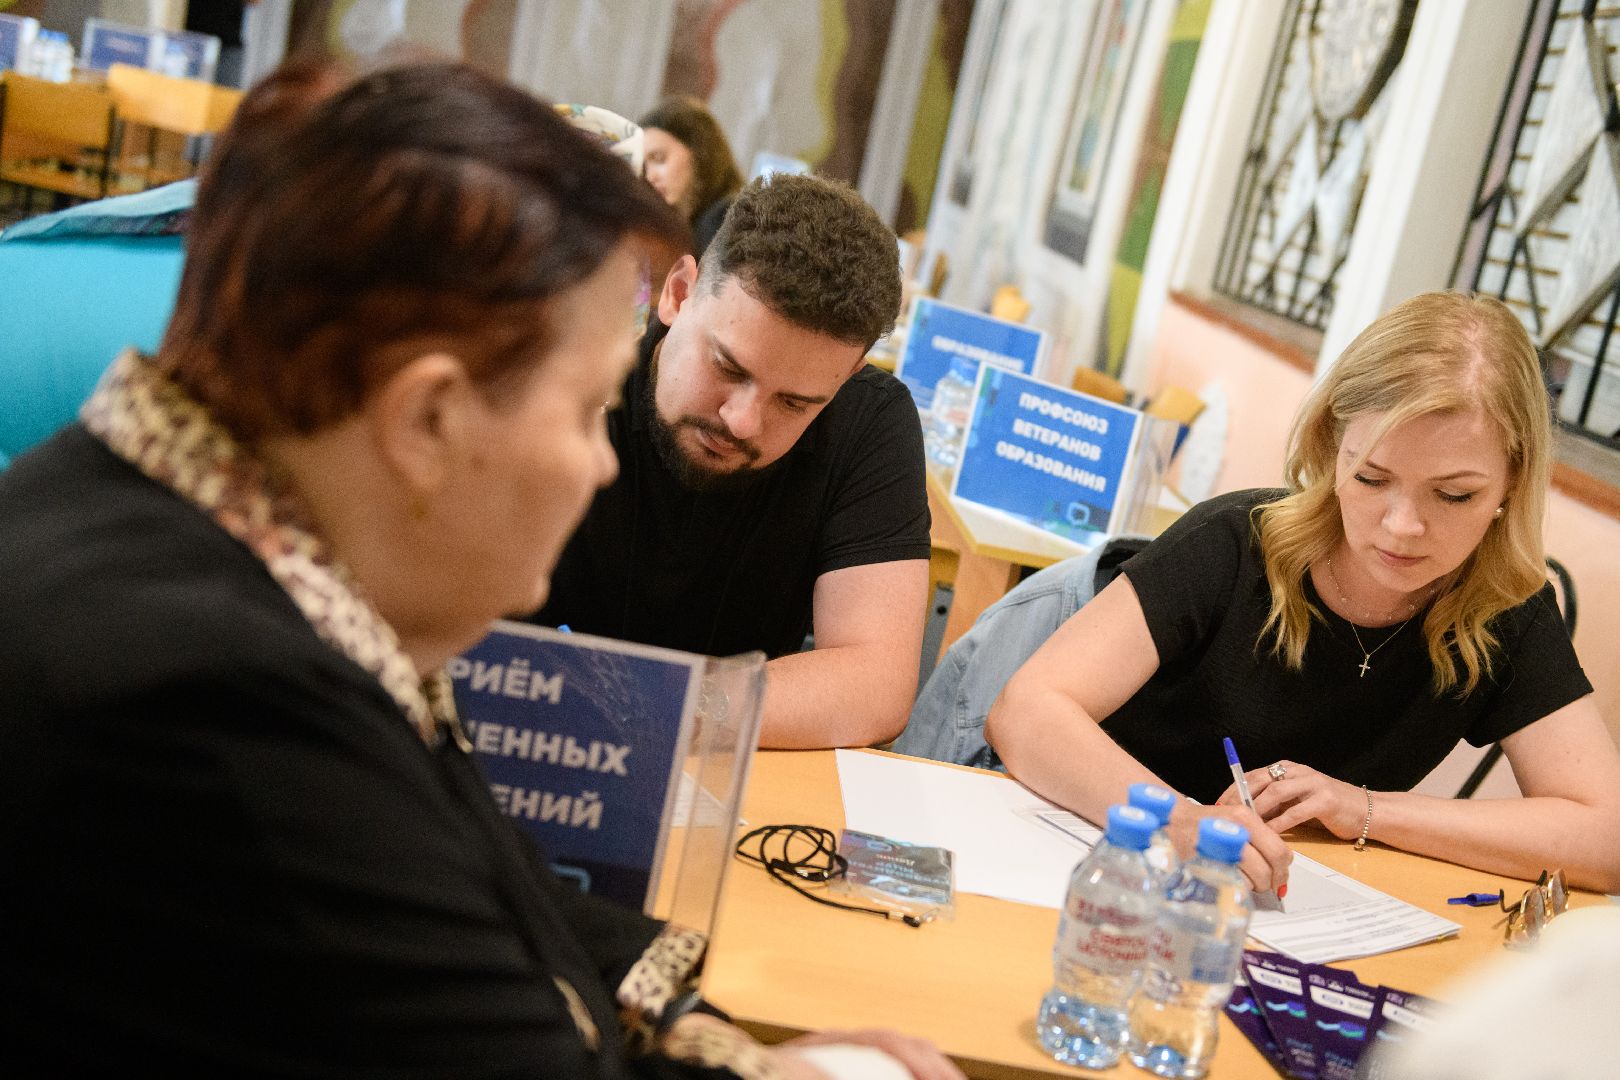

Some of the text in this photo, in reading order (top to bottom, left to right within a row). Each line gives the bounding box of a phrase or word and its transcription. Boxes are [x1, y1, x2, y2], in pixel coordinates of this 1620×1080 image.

[1018, 391, 1110, 435] ПРОФСОЮЗ
[1012, 418, 1102, 462] ВЕТЕРАНОВ
[995, 441, 1107, 493] ОБРАЗОВАНИЯ
[467, 720, 631, 777] ЕННЫХ
